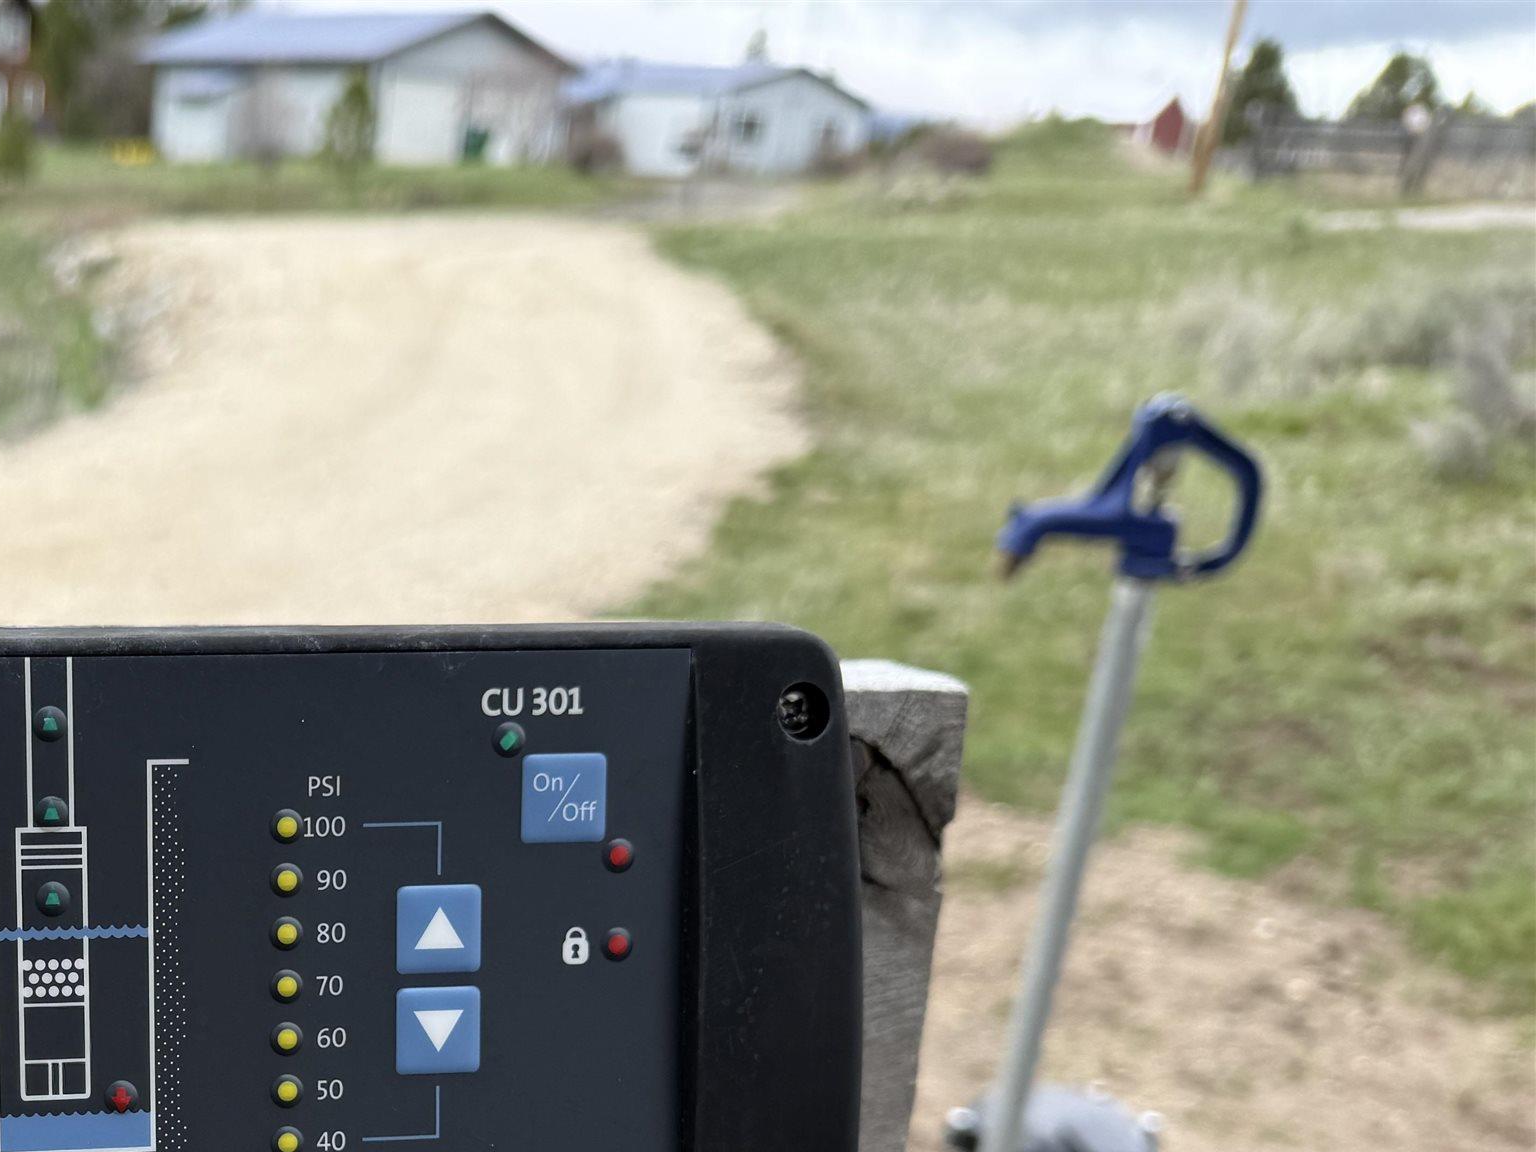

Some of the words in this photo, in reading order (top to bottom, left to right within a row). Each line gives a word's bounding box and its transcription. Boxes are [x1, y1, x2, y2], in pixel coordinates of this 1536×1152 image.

[481, 687, 524, 717] CU
[531, 686, 584, 716] 301
[308, 775, 341, 797] PSI
[562, 800, 597, 822] Off
[303, 815, 346, 838] 100
[316, 869, 347, 891] 90
[316, 922, 346, 944] 80
[315, 975, 344, 996] 70
[317, 1027, 347, 1049] 60
[317, 1079, 344, 1101] 50
[316, 1130, 346, 1152] 40
